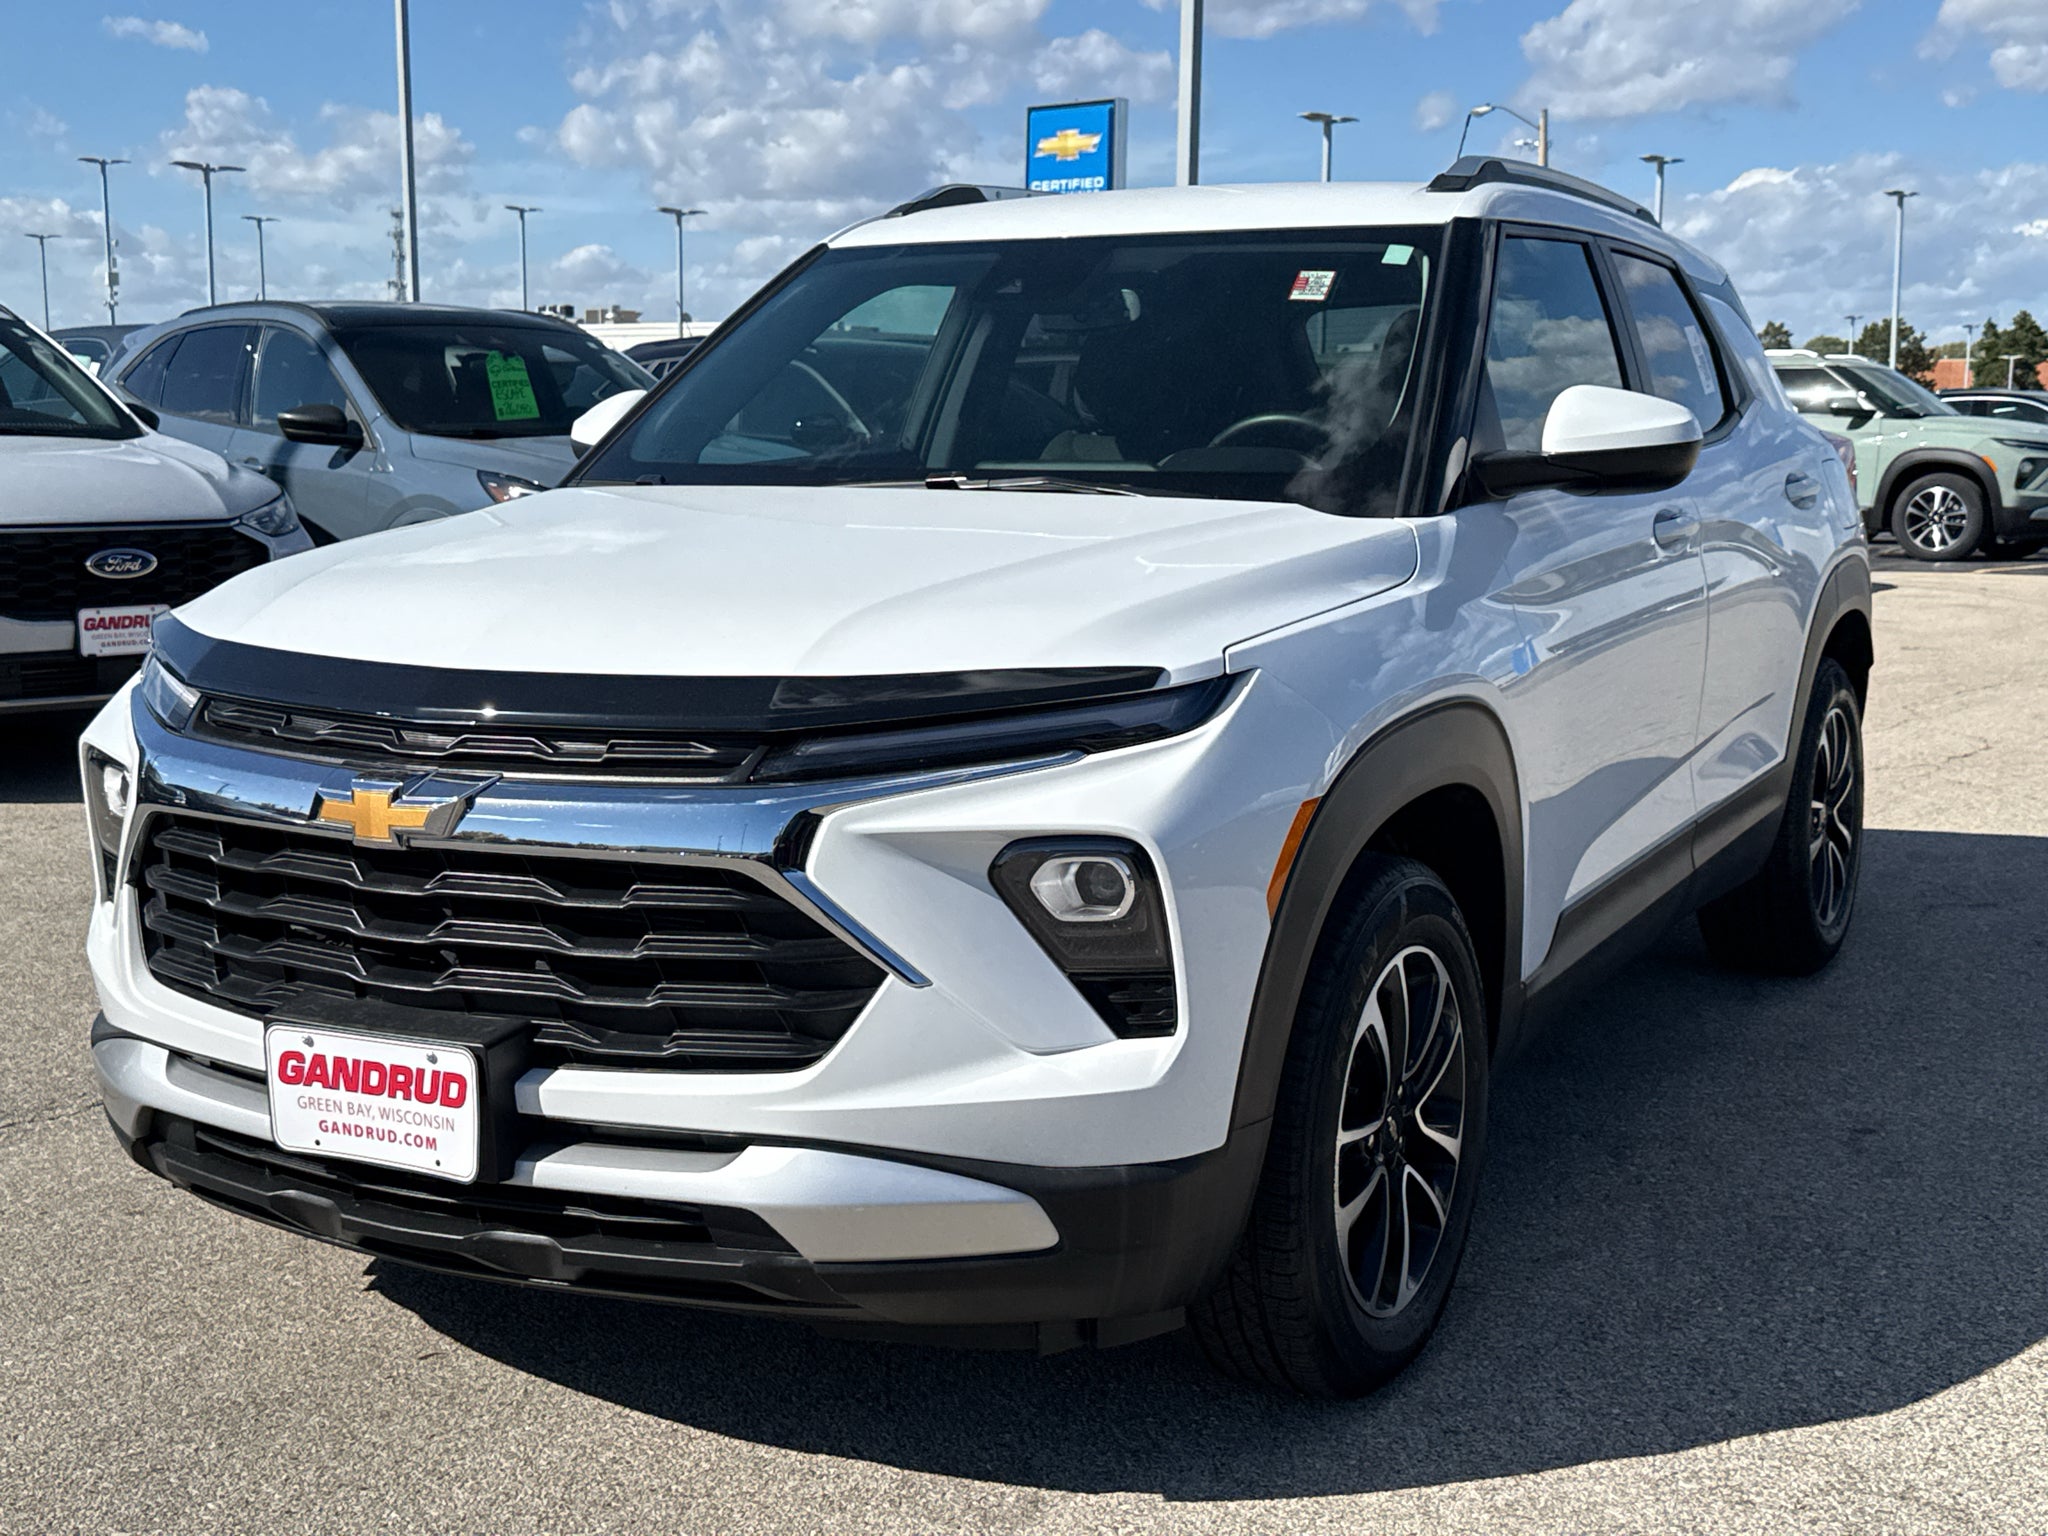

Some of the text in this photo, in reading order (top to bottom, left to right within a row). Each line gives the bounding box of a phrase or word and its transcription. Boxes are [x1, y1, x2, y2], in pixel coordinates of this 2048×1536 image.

[1031, 176, 1105, 192] CERTIFIED
[104, 555, 142, 572] Ford
[84, 614, 156, 631] GANDRU
[278, 1050, 468, 1109] GANDRUD
[297, 1095, 455, 1132] GREEN BAY, WISCONSIN
[318, 1119, 438, 1151] GANDRUD.COM
